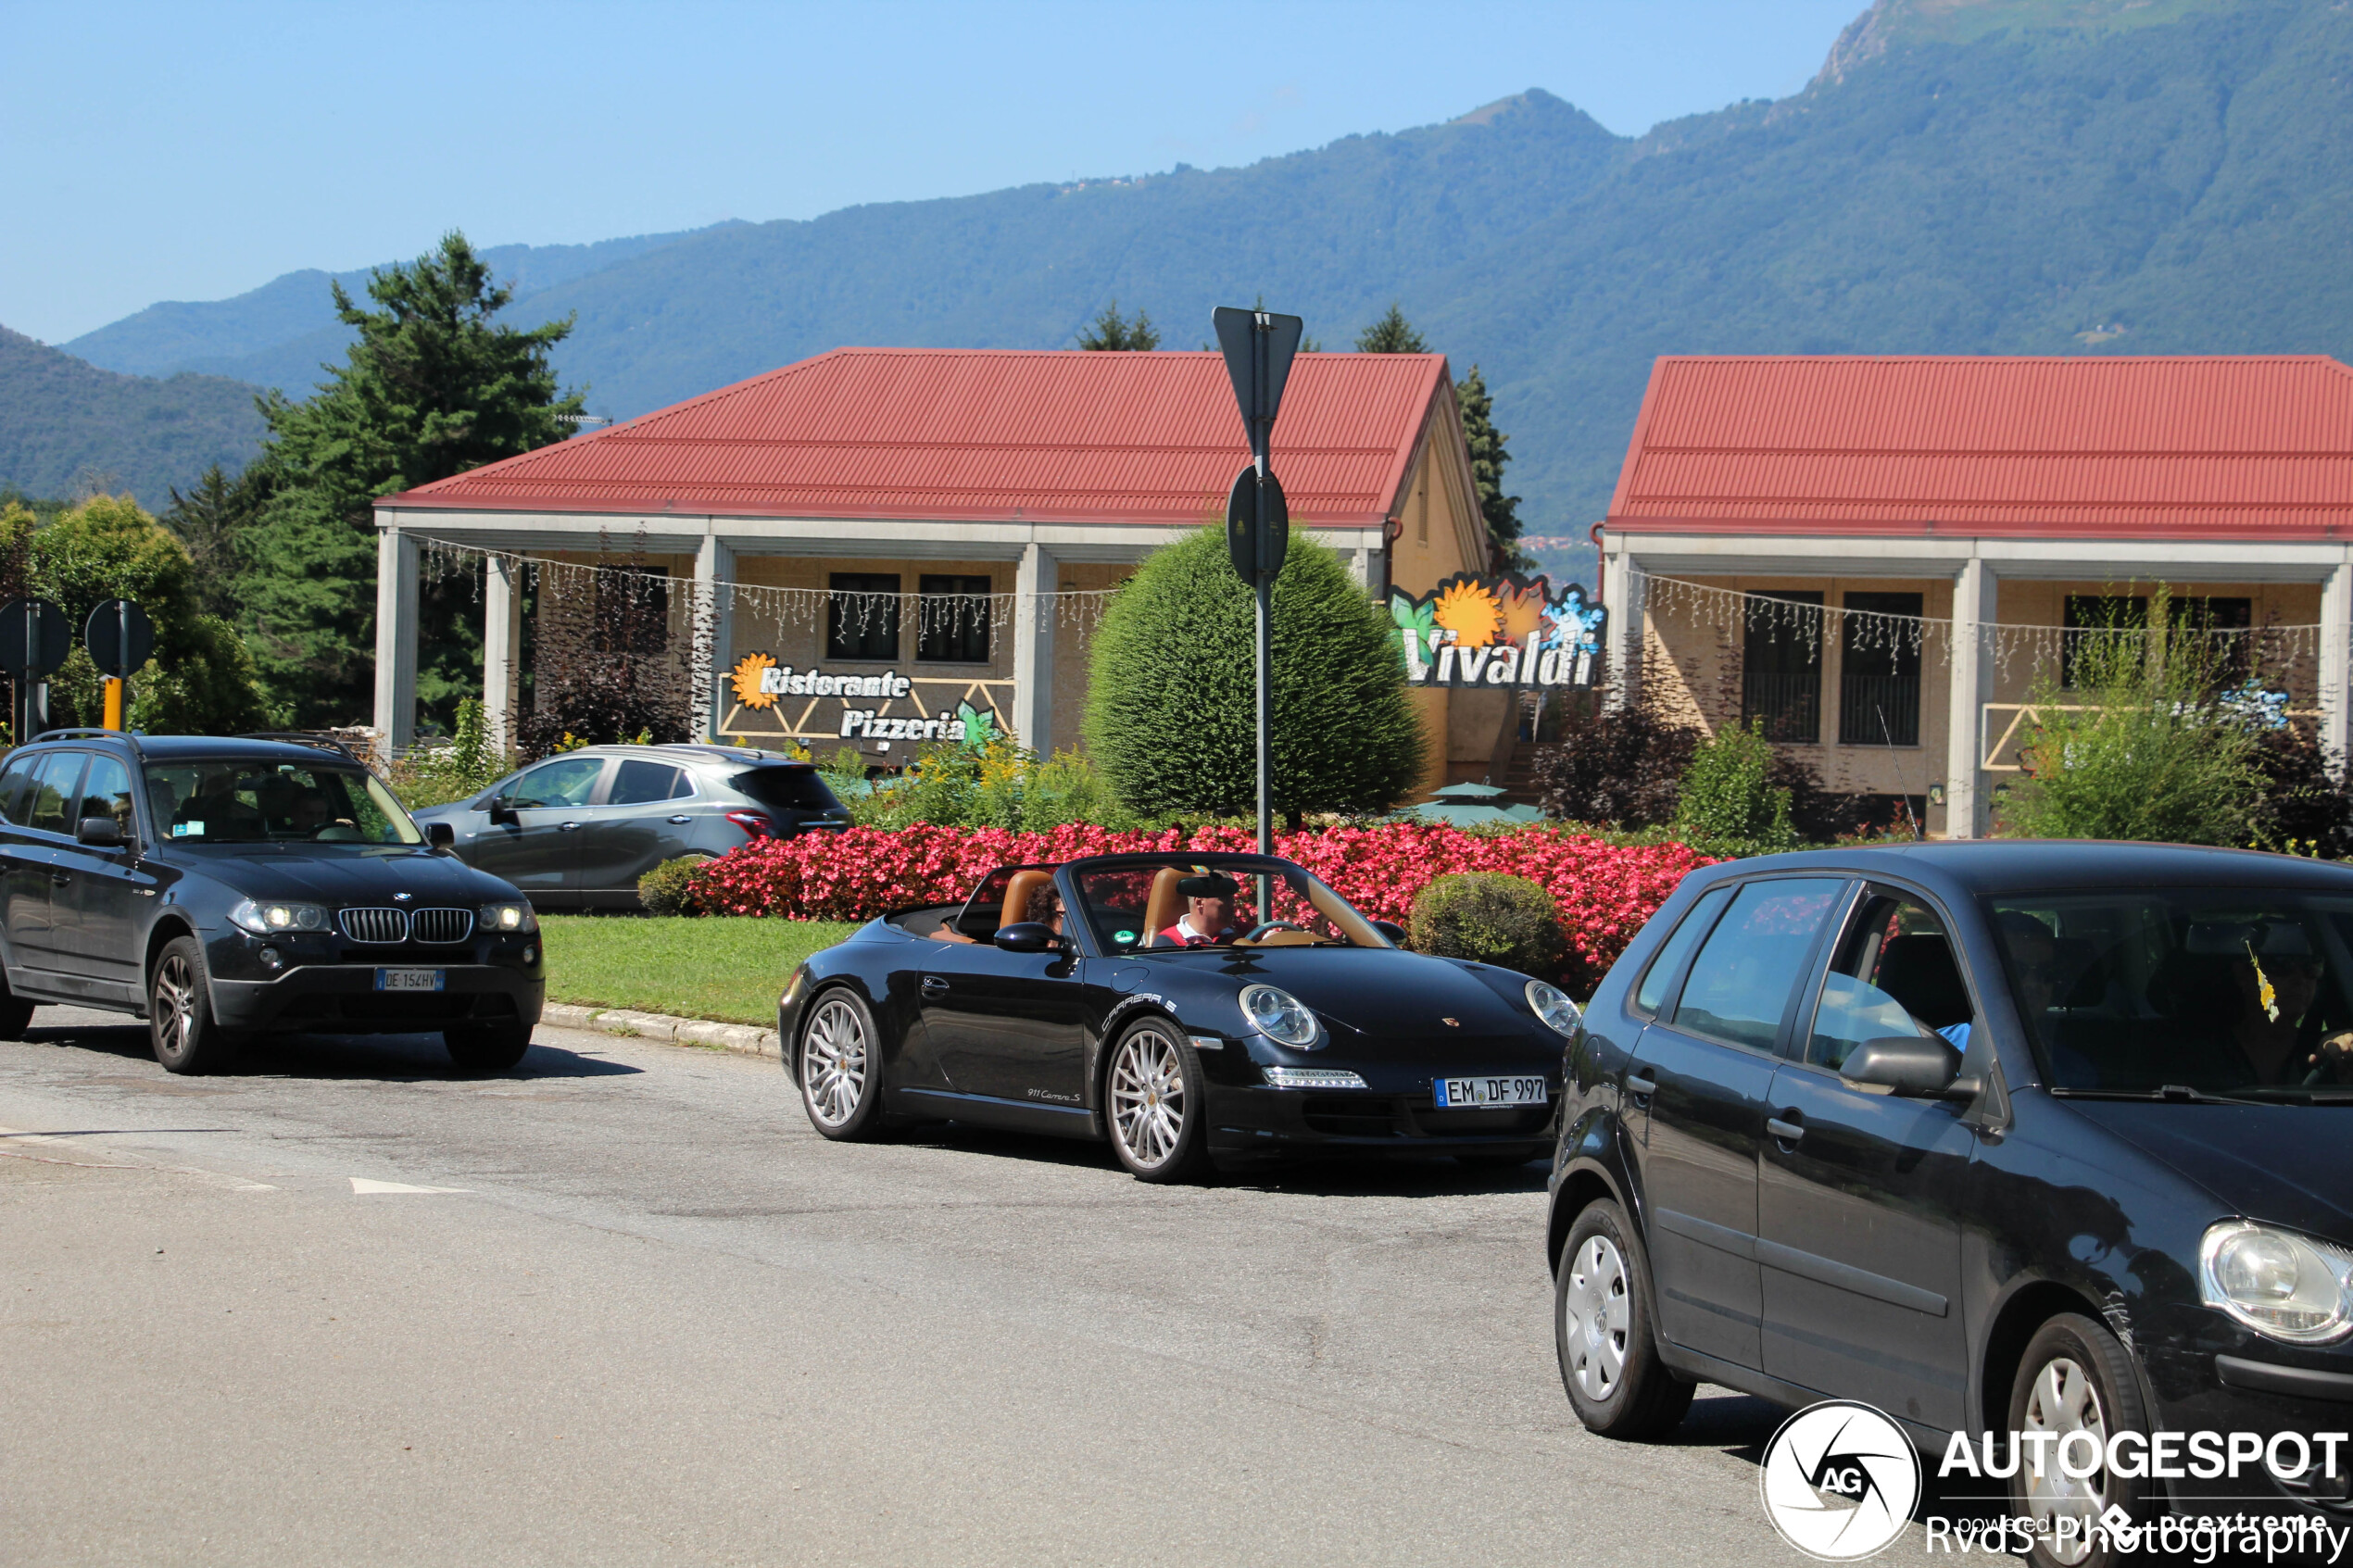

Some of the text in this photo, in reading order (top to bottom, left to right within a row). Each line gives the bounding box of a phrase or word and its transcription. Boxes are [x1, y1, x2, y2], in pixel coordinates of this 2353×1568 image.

[1401, 626, 1596, 685] Vivaldi
[760, 667, 912, 697] Ristorante
[840, 709, 966, 741] Pizzeria
[385, 973, 399, 987] DE
[1101, 992, 1162, 1033] CARRERA
[1164, 999, 1177, 1013] S
[1027, 1088, 1040, 1098] 911
[1040, 1089, 1070, 1101] Carrera
[1447, 1078, 1543, 1103] EM DF 997
